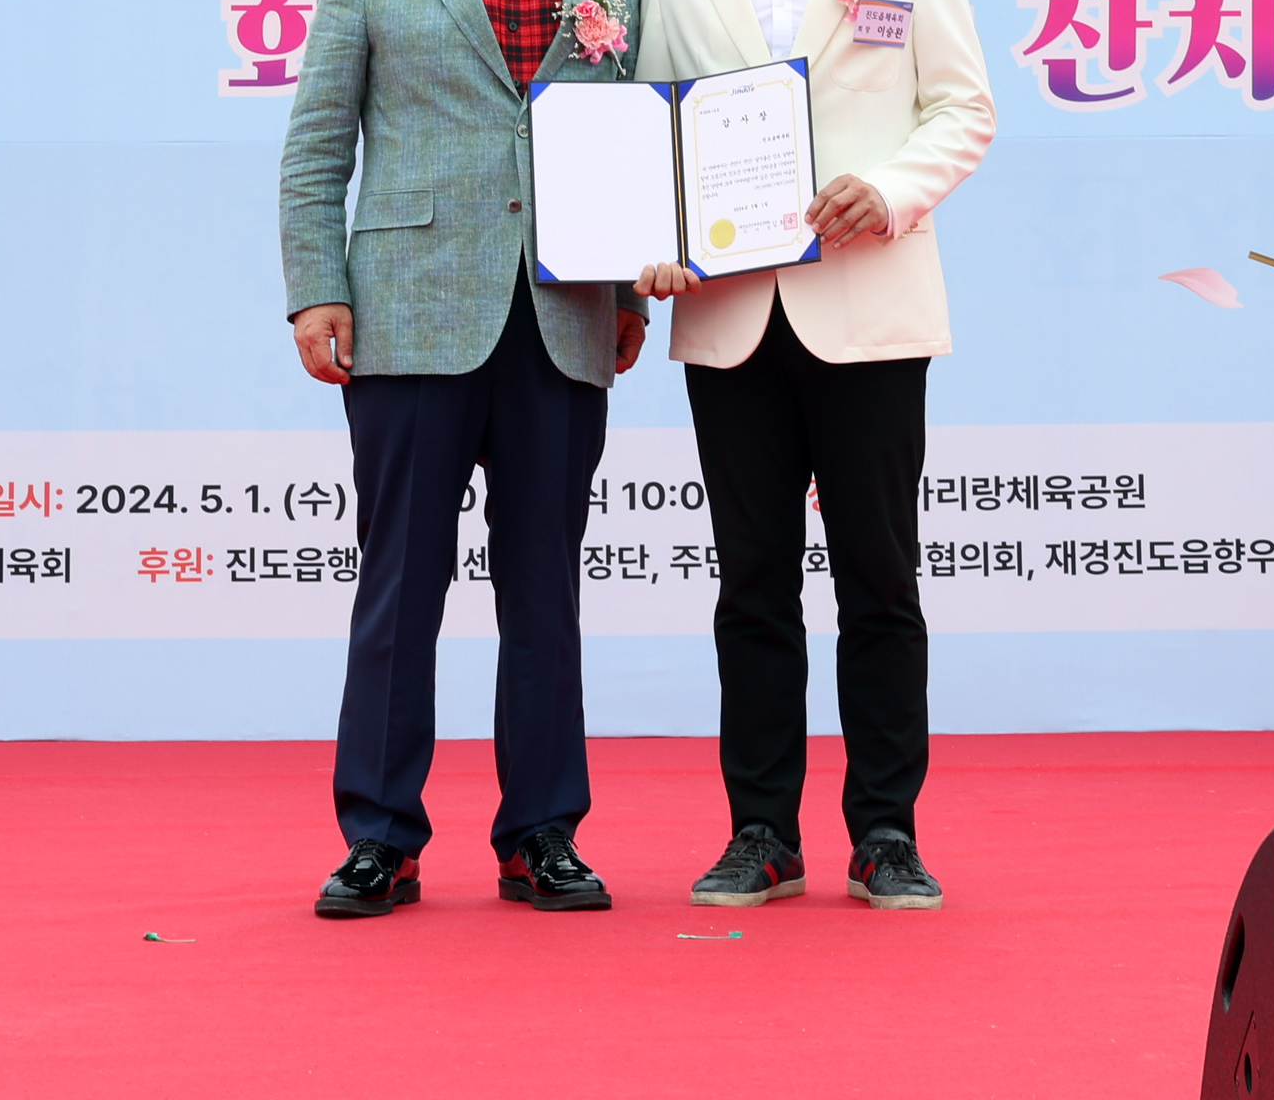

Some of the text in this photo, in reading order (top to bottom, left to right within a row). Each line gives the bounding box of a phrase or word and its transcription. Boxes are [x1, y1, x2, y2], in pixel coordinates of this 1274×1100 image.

[75, 482, 189, 515] 2024.
[199, 482, 234, 515] 5.
[244, 482, 272, 515] 1.
[282, 481, 347, 522] (수)
[622, 480, 706, 512] 10:0
[137, 546, 215, 584] 후원:
[582, 543, 660, 586] 장단,
[914, 540, 1035, 582] 협의회,
